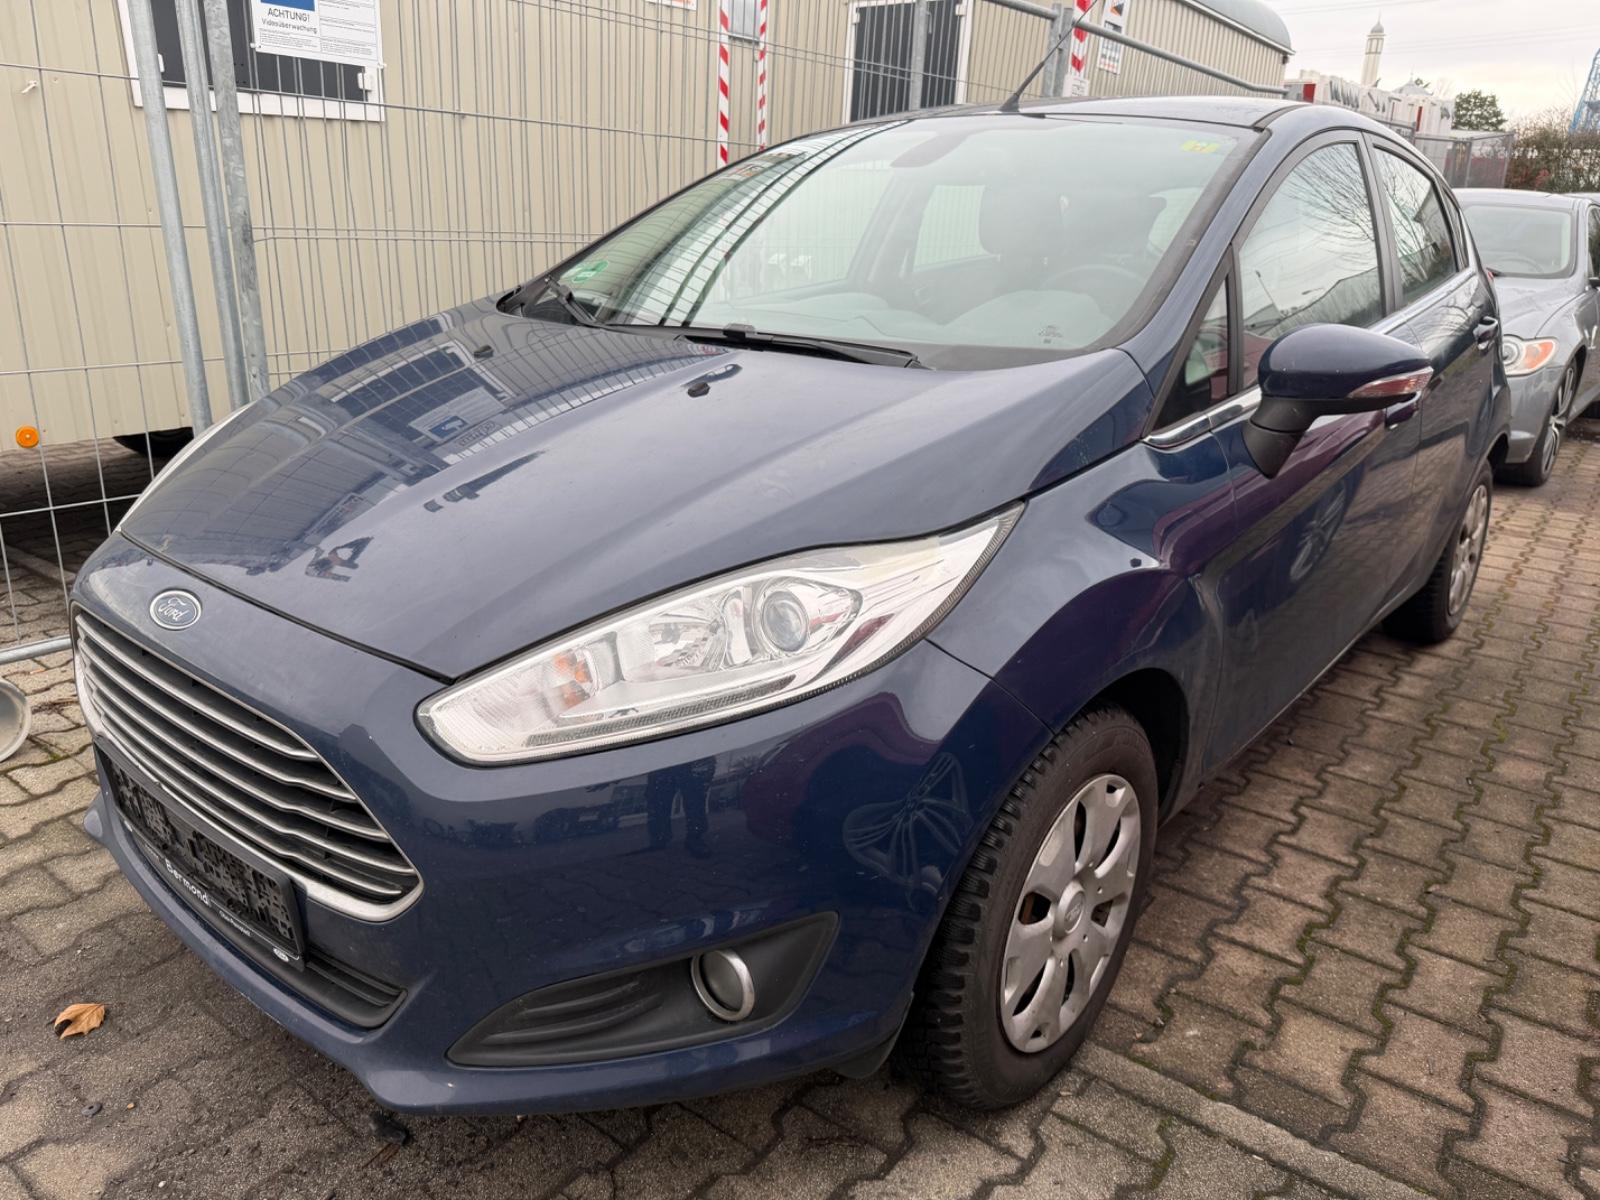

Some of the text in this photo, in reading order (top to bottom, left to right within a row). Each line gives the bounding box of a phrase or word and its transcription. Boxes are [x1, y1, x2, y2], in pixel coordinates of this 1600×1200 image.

[267, 7, 310, 22] ACHTUNG!
[262, 18, 317, 34] Videoüberwachung
[158, 597, 190, 622] Ford
